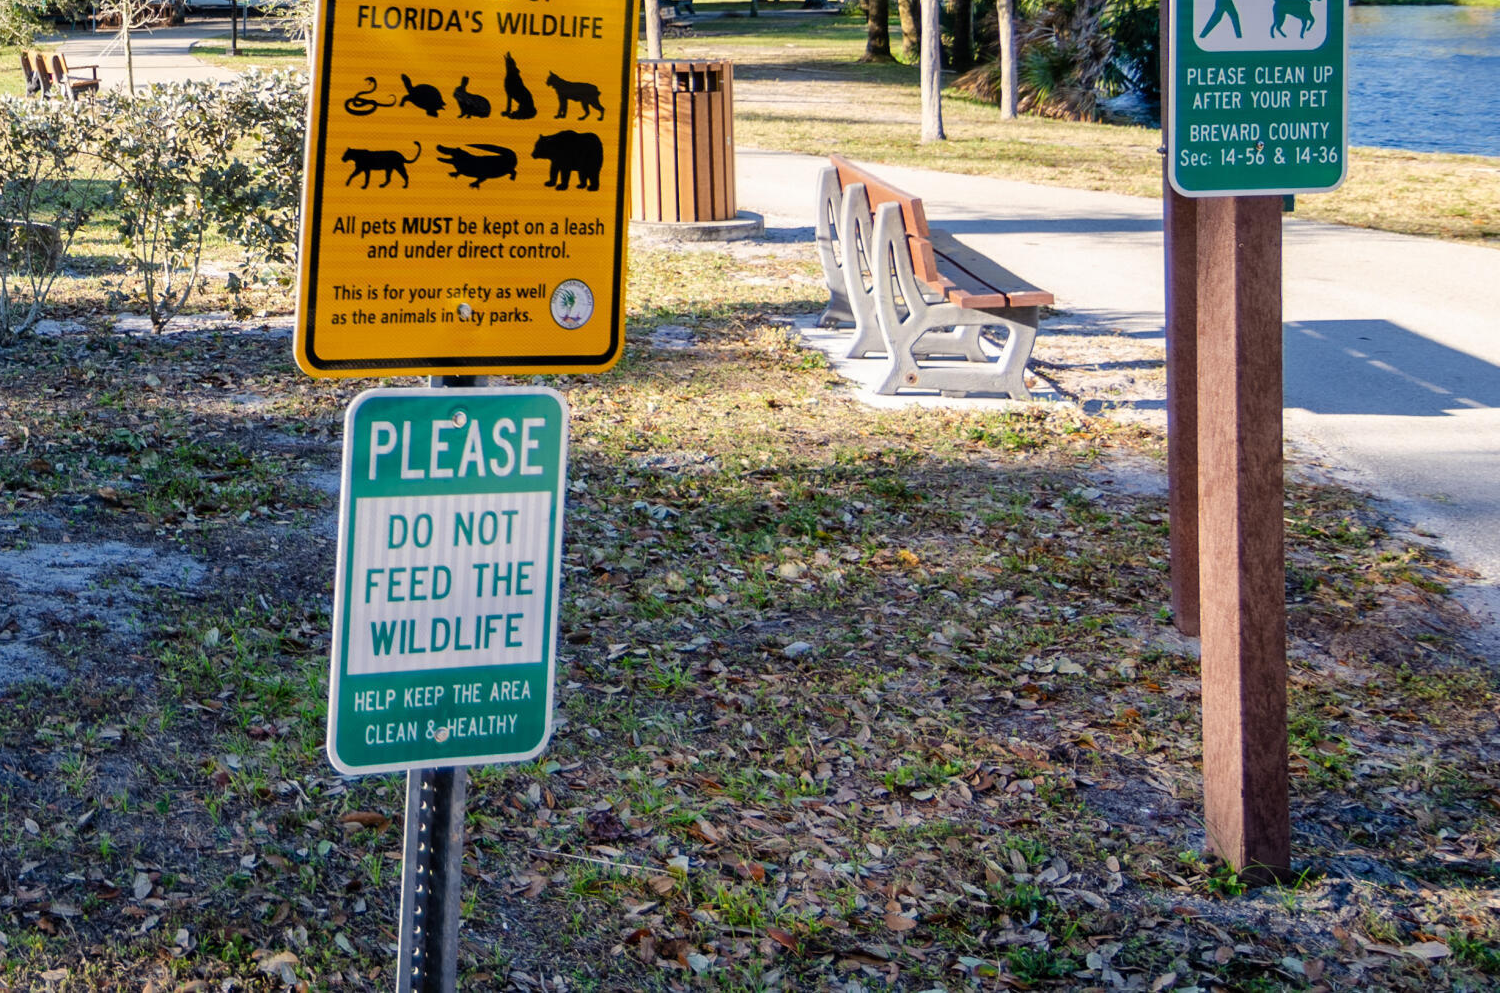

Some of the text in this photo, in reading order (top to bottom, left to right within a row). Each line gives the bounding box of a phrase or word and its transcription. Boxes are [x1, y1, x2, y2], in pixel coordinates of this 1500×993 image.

[358, 5, 603, 39] FLORIDA'S WILDLIFE
[1188, 66, 1333, 85] PLEASE CLEAN UP
[1193, 90, 1328, 109] AFTER YOUR PET
[1190, 122, 1329, 142] BREVARD COUNTY
[1180, 146, 1337, 166] Sec: 14-56 & 14-36
[333, 217, 604, 238] All pets MUST be kept on a leash
[367, 242, 570, 259] and under direct control.
[333, 284, 546, 303] This is for your safety as well
[332, 309, 532, 326] as the animals in ty parks.
[368, 418, 545, 480] PLEASE
[389, 510, 519, 549] DO NOT
[365, 561, 534, 604] FEED THE
[371, 613, 524, 656] WILDLIFE
[355, 680, 530, 711] HELP KEEP THE AREA
[365, 714, 518, 744] CLEAN & HEALTHY
